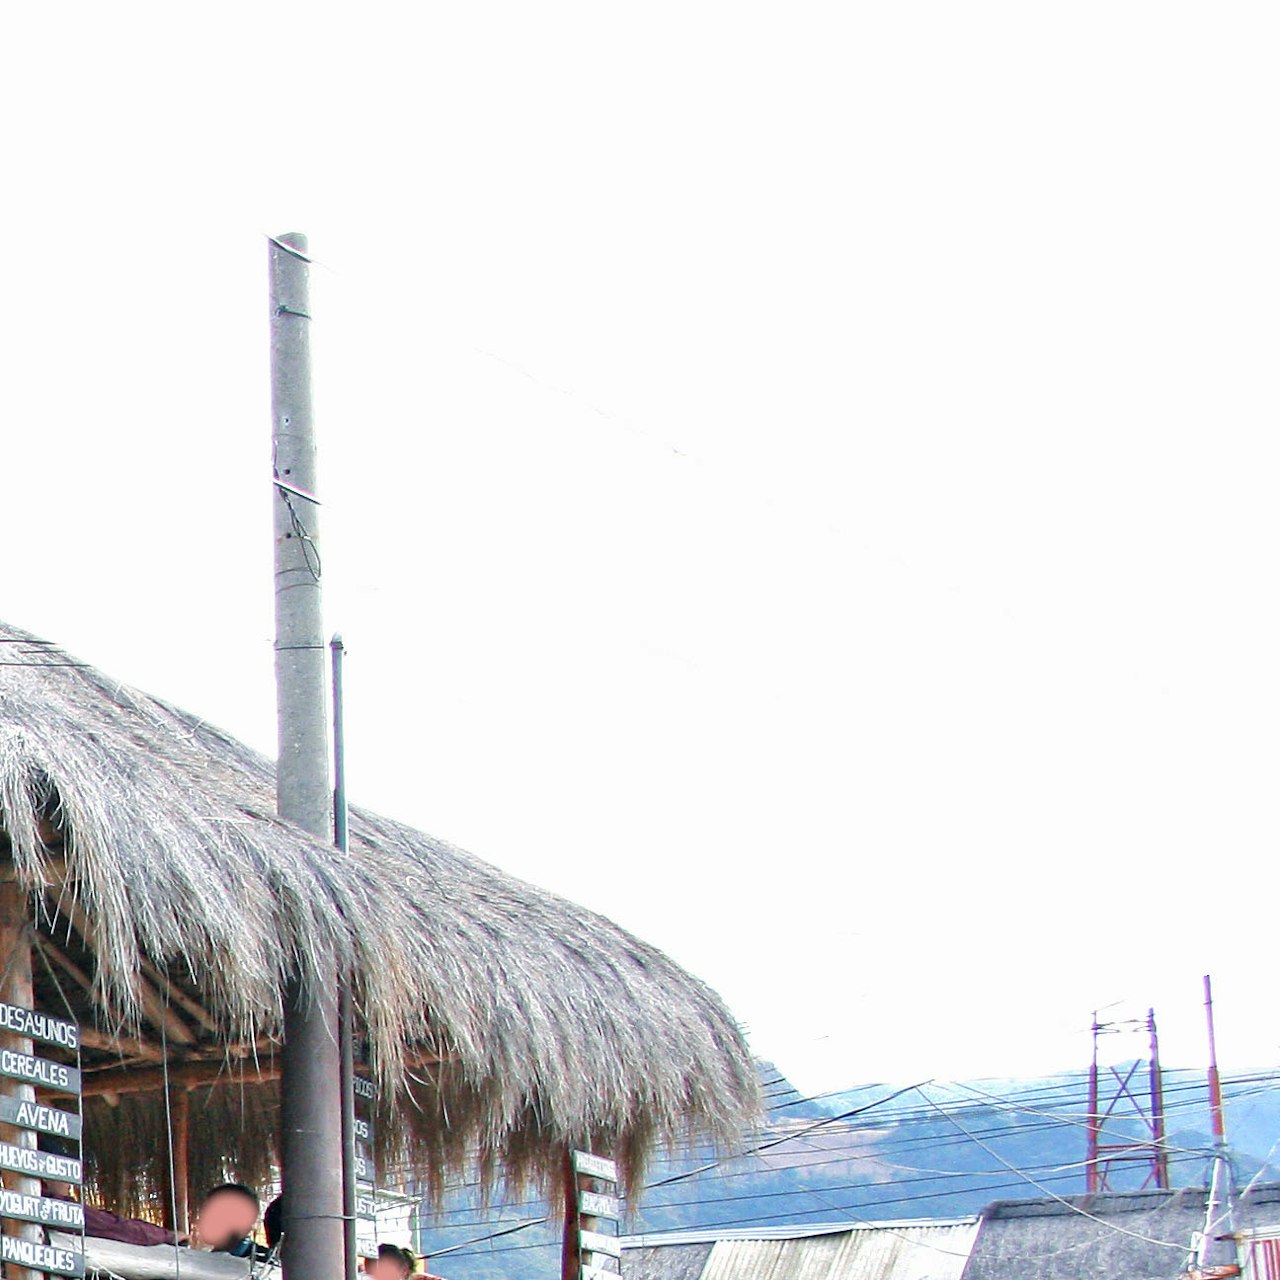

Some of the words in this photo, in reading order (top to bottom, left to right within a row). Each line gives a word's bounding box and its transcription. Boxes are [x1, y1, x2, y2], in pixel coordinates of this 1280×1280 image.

[1, 1051, 69, 1086] CEREALES
[17, 1103, 70, 1136] AVENA
[46, 1155, 80, 1179] GUSTO
[0, 1190, 40, 1218] YOGURT
[52, 1201, 85, 1225] FRUTA
[2, 1237, 75, 1271] PANQUEQUES
